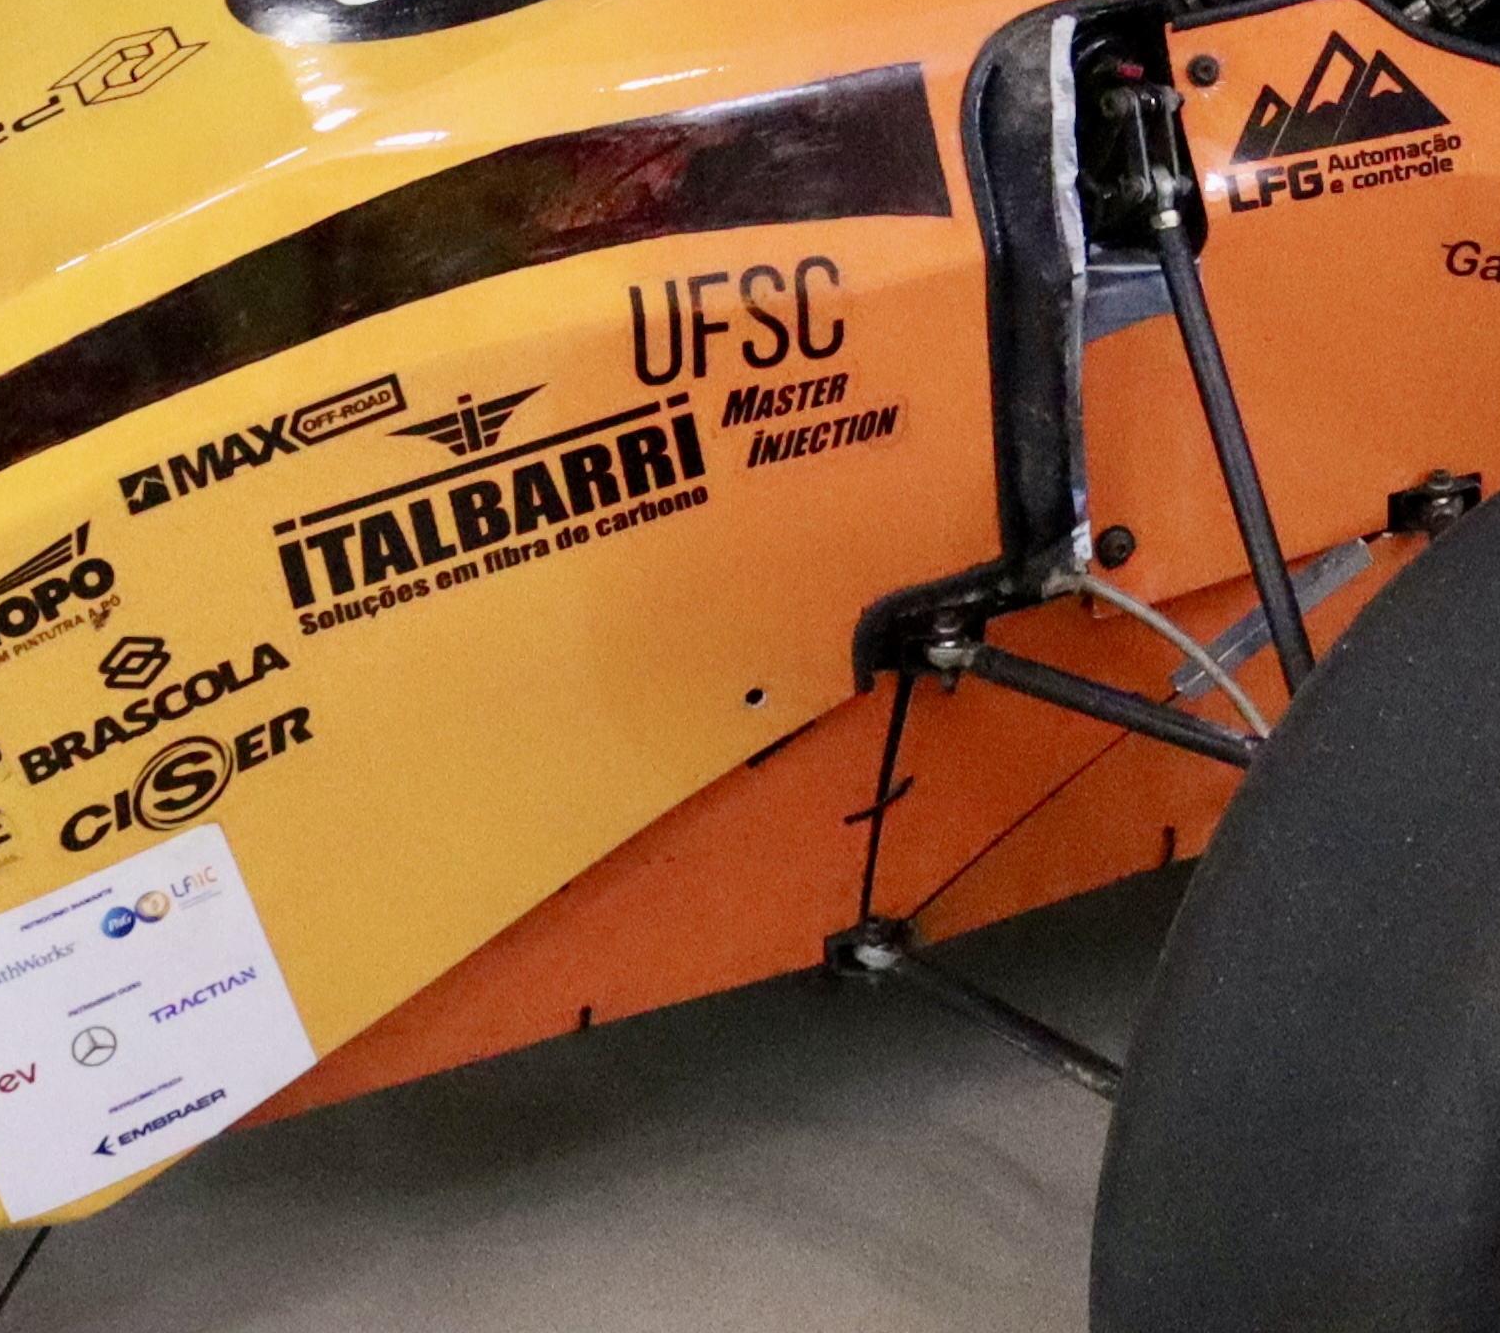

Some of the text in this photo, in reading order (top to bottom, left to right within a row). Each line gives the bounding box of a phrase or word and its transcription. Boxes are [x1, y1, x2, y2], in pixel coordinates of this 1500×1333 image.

[1328, 131, 1462, 175] Automação
[1330, 154, 1454, 195] e controle
[1227, 159, 1325, 214] LFG
[628, 255, 845, 387] UFSC
[301, 386, 393, 436] OFF-ROAD
[721, 373, 849, 430] MASTER
[167, 413, 300, 498] MAX
[299, 483, 709, 637] Soluções em fibra de carbono
[19, 641, 290, 786] BRASCOLA
[60, 704, 314, 853] CISER
[149, 966, 258, 1025] TRACTIAN
[117, 1087, 228, 1148] EMBRAER
